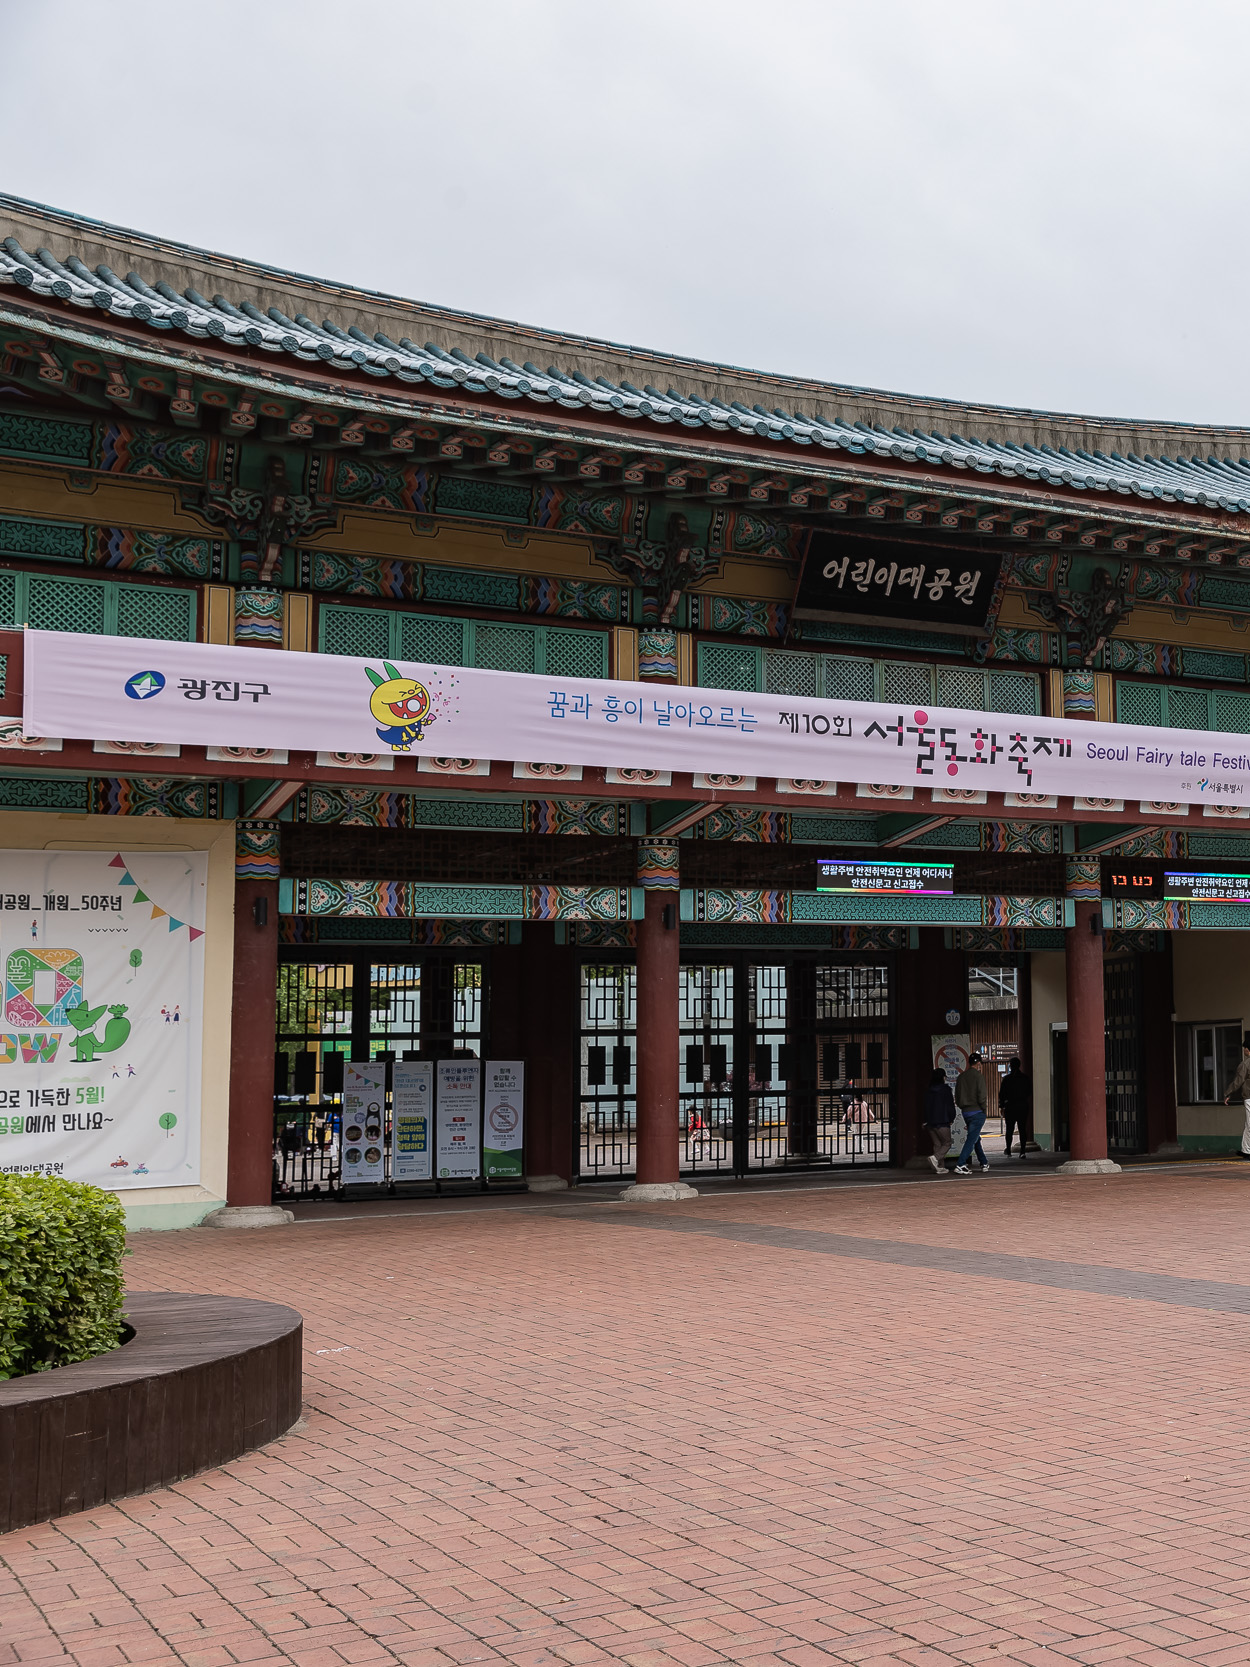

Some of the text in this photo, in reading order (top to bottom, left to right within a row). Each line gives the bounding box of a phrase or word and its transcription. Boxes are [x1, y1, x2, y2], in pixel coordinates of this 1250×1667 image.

[822, 556, 982, 605] 어린이대공원
[177, 677, 271, 703] 광진구
[547, 691, 1072, 786] 꿈과 흥이 날아오르는 제10회 서울동화축제
[1086, 742, 1129, 763] Seoul
[1136, 747, 1174, 768] Fairy
[1180, 750, 1206, 767] tale
[1208, 782, 1244, 794] 서울특별시
[821, 865, 854, 876] 생활주변
[905, 867, 921, 878] 언제
[922, 868, 953, 879] 어디서나
[851, 878, 924, 889] 안전신문고 신고접수
[1235, 878, 1248, 888] 언제
[1191, 888, 1250, 899] 안전신문고 신고접수
[27, 1088, 71, 1107] 가득찬
[76, 1086, 105, 1104] 5월!
[62, 1112, 114, 1131] 만나요~
[0, 1162, 64, 1176] 어린이대공원
